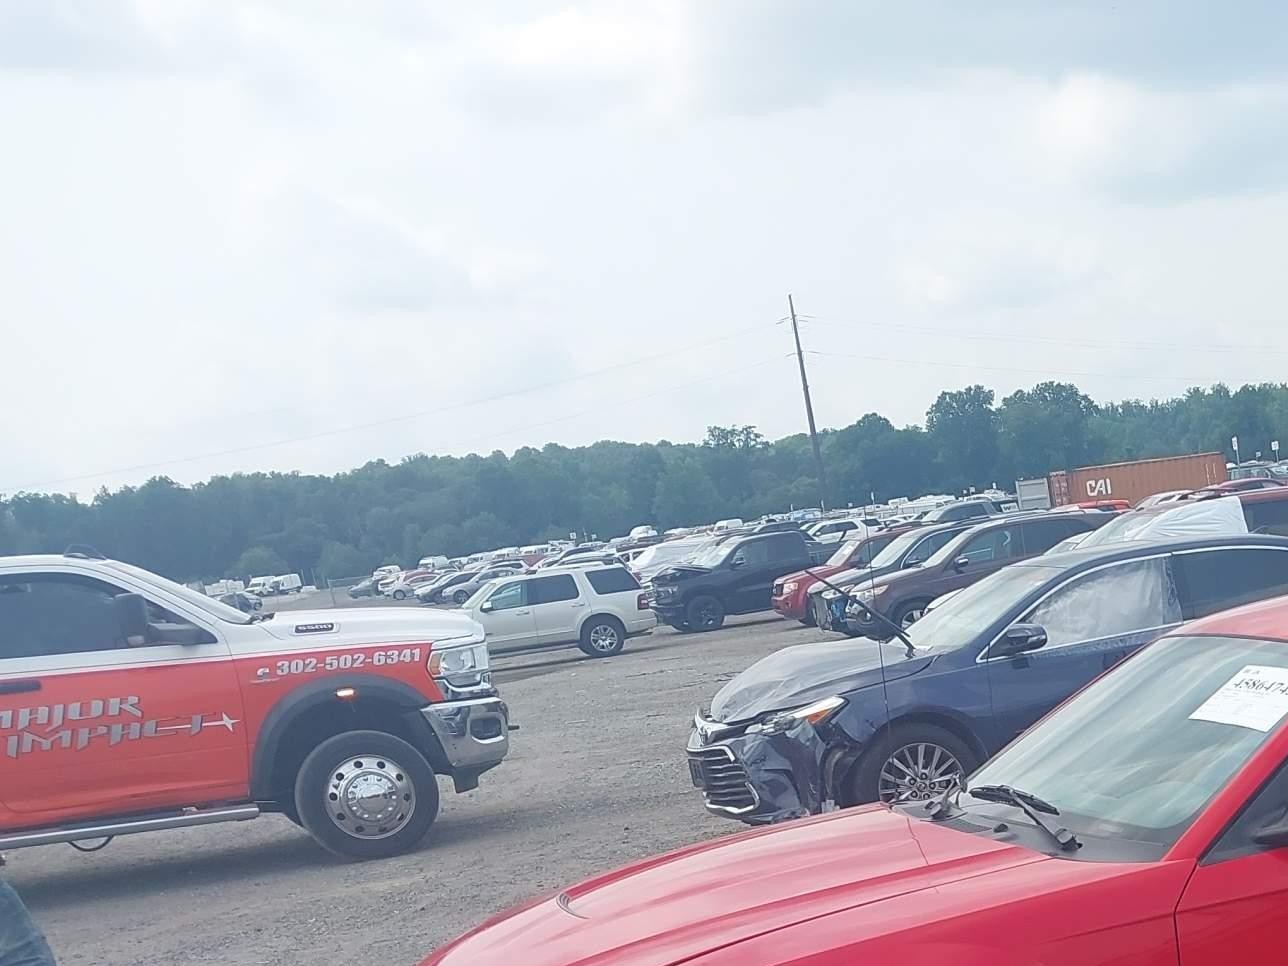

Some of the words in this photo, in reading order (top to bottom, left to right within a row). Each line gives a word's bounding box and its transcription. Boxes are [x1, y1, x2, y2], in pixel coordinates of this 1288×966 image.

[1086, 478, 1112, 497] CAI
[276, 648, 421, 676] 302-502-6341
[0, 696, 142, 732] AJOR
[7, 711, 217, 758] IMPACT
